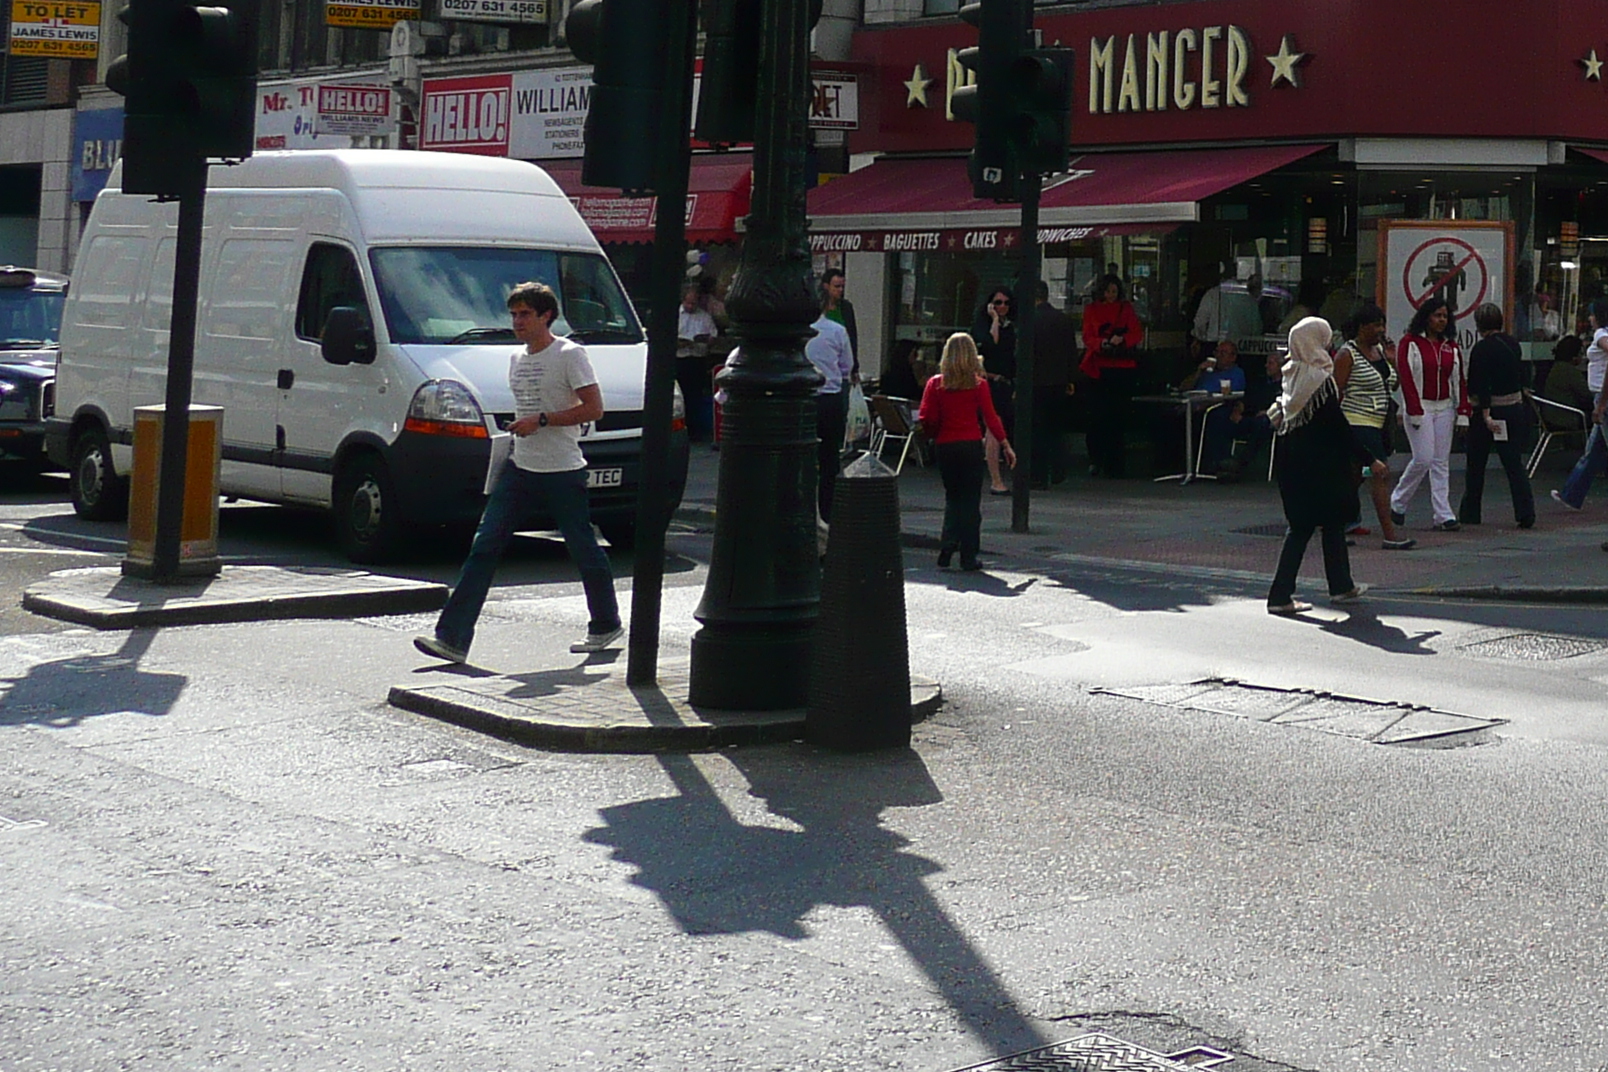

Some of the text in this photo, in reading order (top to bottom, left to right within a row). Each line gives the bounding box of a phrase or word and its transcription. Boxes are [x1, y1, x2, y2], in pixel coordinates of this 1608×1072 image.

[23, 5, 88, 18] TO LET
[328, 7, 358, 18] 0207
[362, 9, 383, 19] 631
[387, 11, 419, 21] 4565
[444, 0, 544, 14] 0207 631 4565
[13, 28, 97, 40] JAMES LEWIS
[12, 40, 40, 49] 0207
[43, 41, 63, 50] 631
[562, 72, 593, 81] TOTTENHA
[1089, 24, 1250, 115] MANGER
[263, 91, 293, 115] Mr.
[322, 89, 386, 114] HELLO!
[517, 86, 591, 115] WILLIAM
[811, 84, 843, 119] RET
[426, 91, 507, 143] HELLO!
[883, 232, 941, 250] BAGUETTES
[964, 231, 997, 249] CAKES
[1036, 228, 1094, 244] DWICHES
[594, 469, 620, 485] TEC
